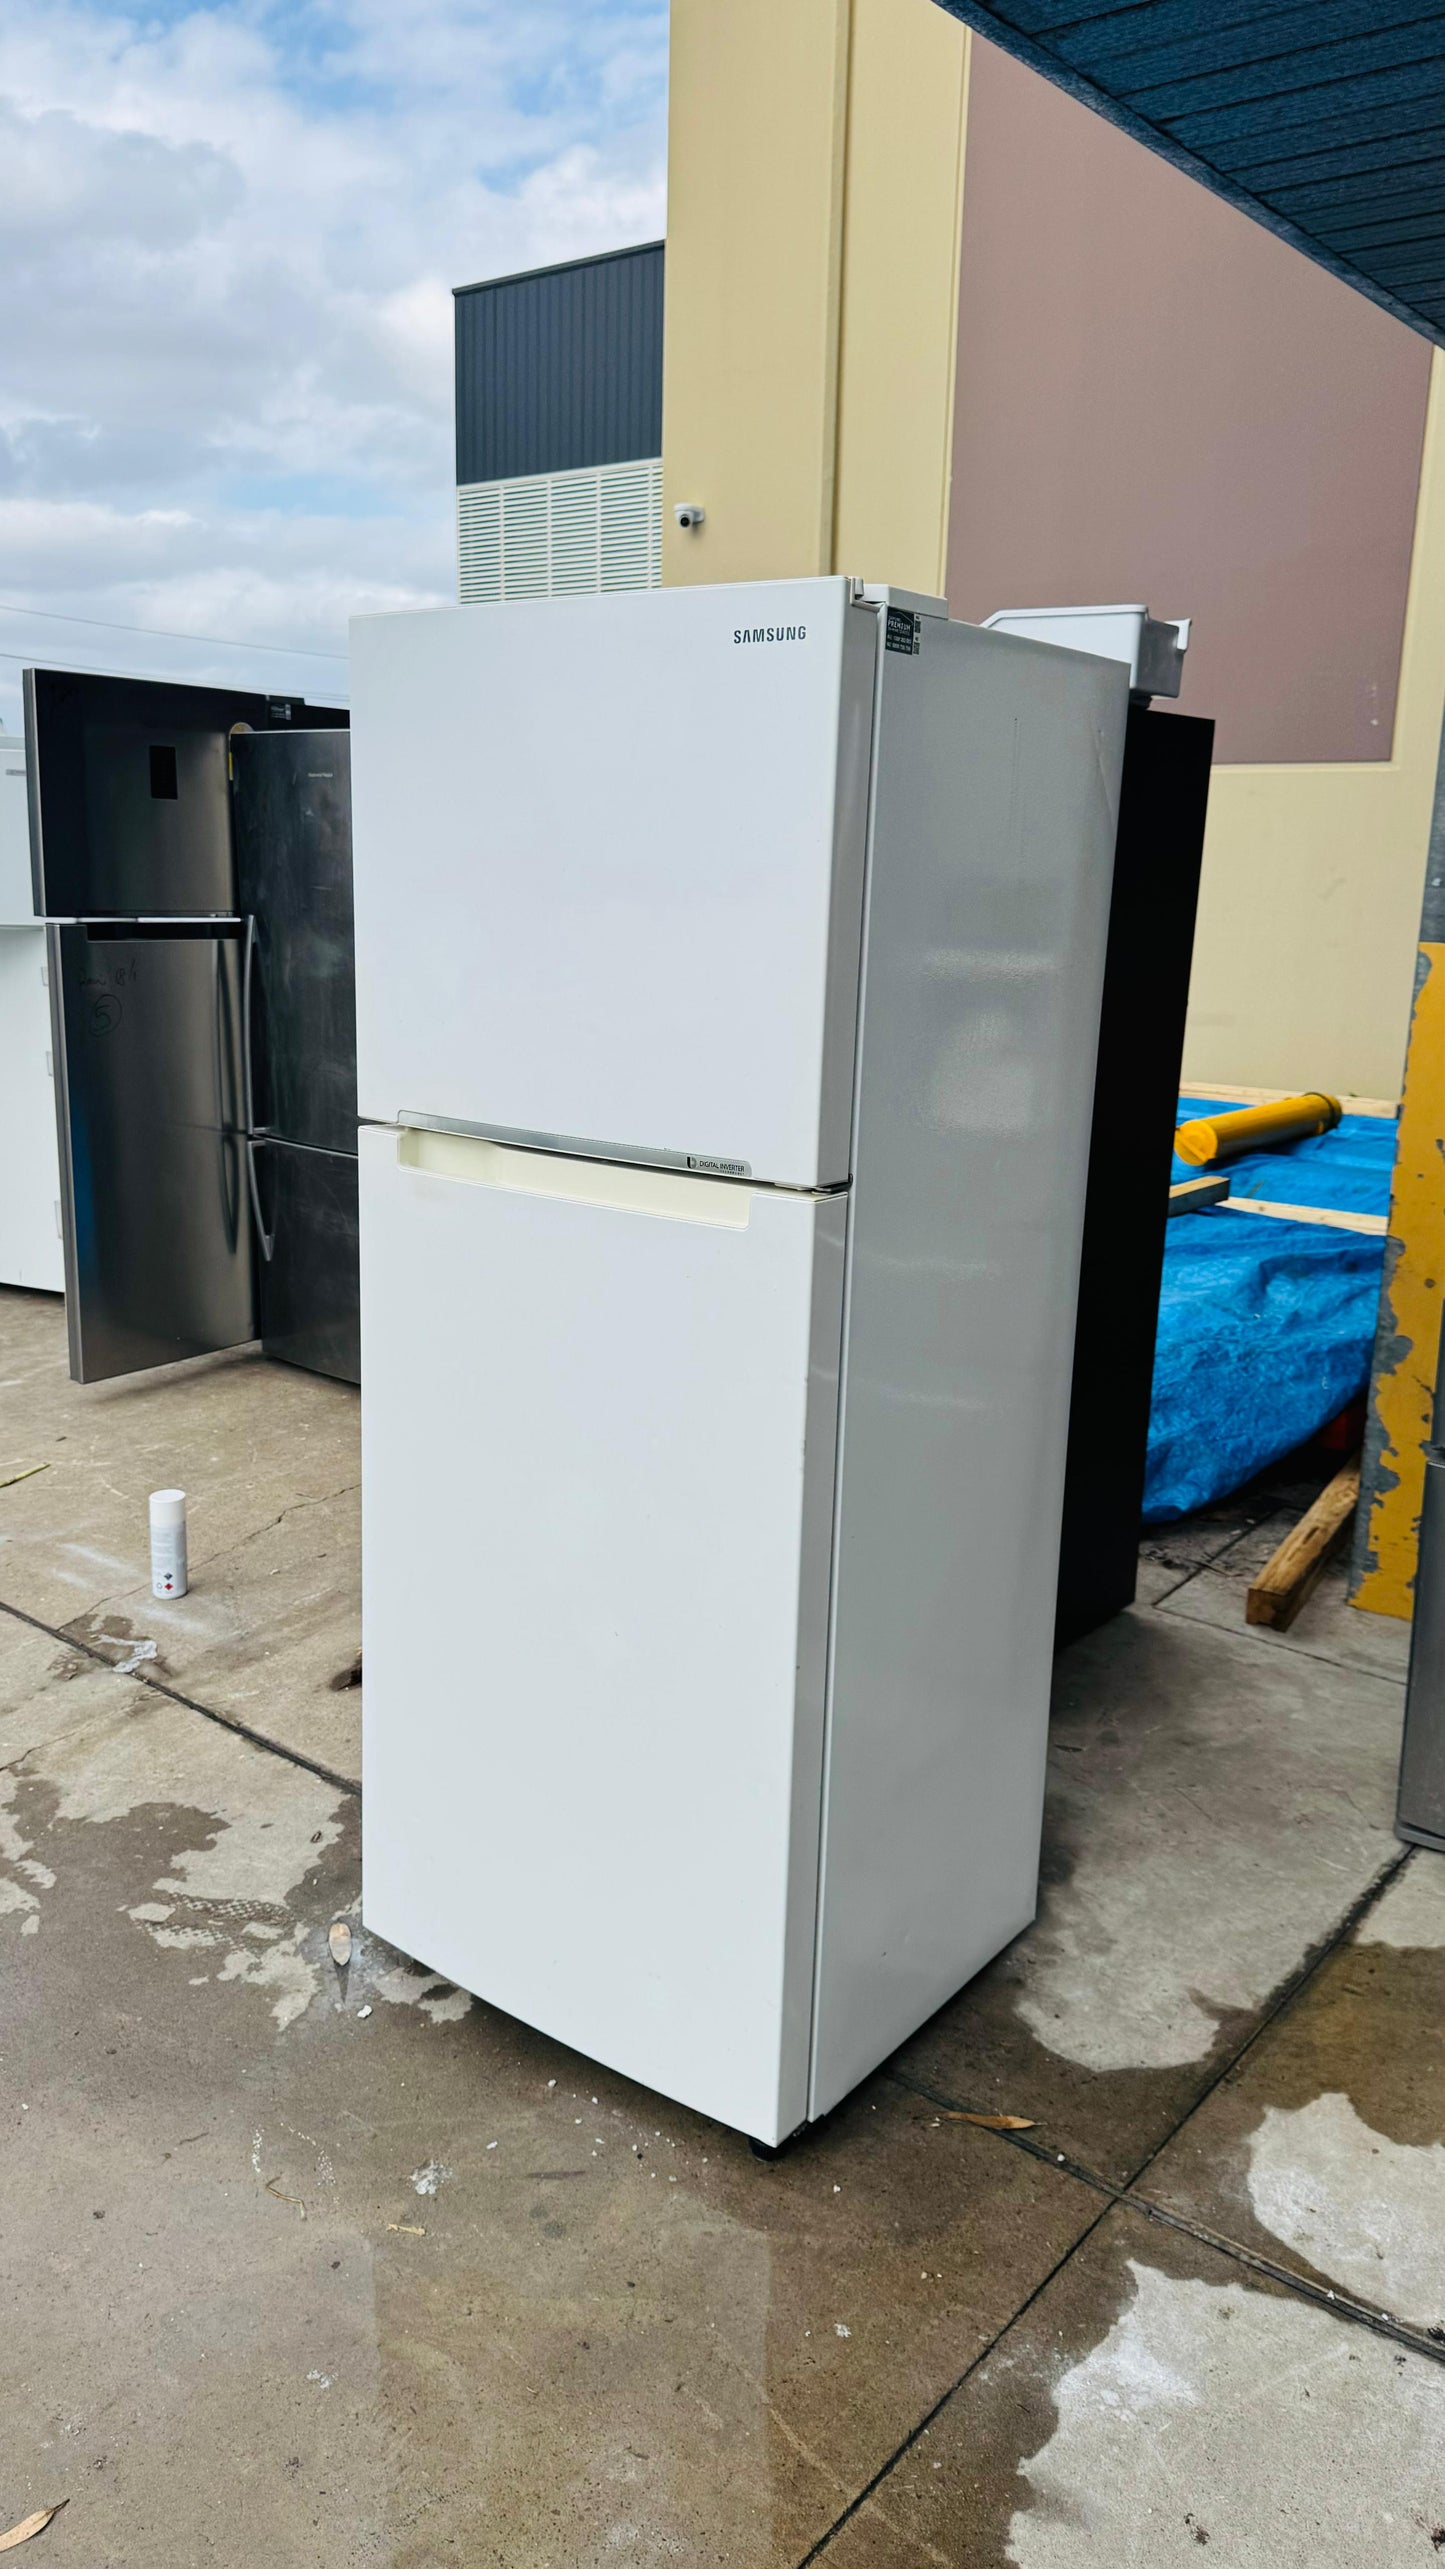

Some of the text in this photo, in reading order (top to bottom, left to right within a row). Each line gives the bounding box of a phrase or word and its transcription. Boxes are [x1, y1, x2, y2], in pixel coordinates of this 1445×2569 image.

[733, 626, 807, 644] SAMSUNG
[699, 1160, 745, 1172] DIGITAL INVERTER
